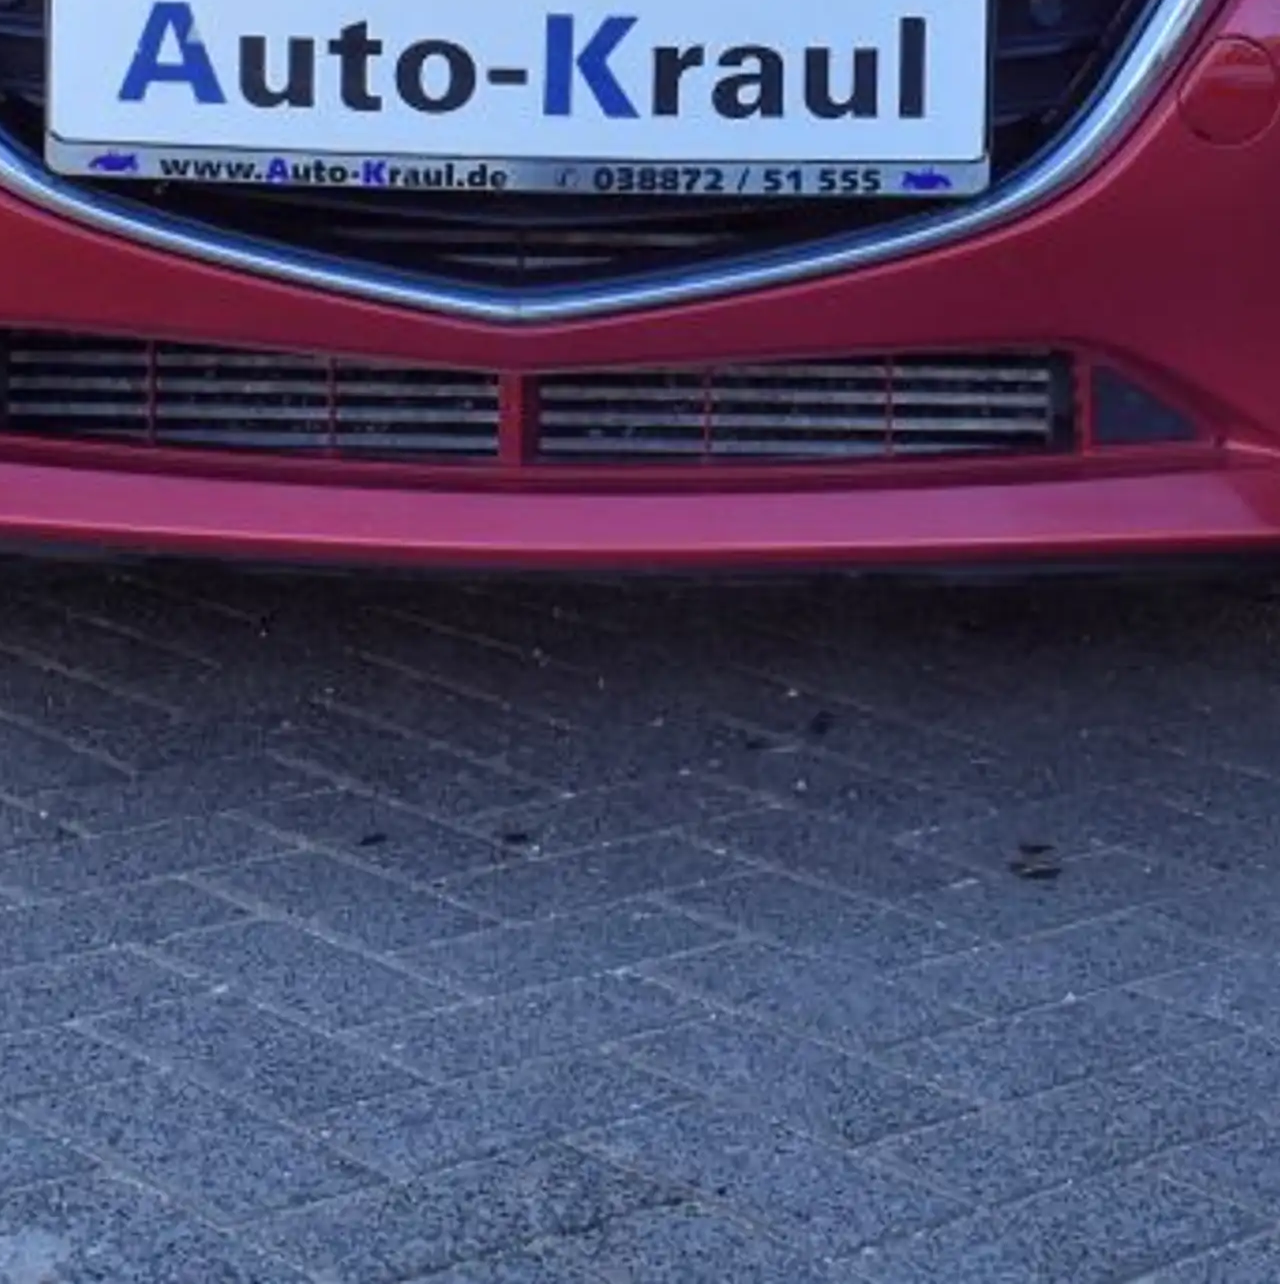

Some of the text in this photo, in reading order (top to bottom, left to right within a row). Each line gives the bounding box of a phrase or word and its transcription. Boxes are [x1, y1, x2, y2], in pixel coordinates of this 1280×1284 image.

[116, 0, 928, 120] Auto-Kraul
[159, 156, 509, 190] www.Auto-Kraul.de
[593, 165, 882, 193] 038872 / 51 555
